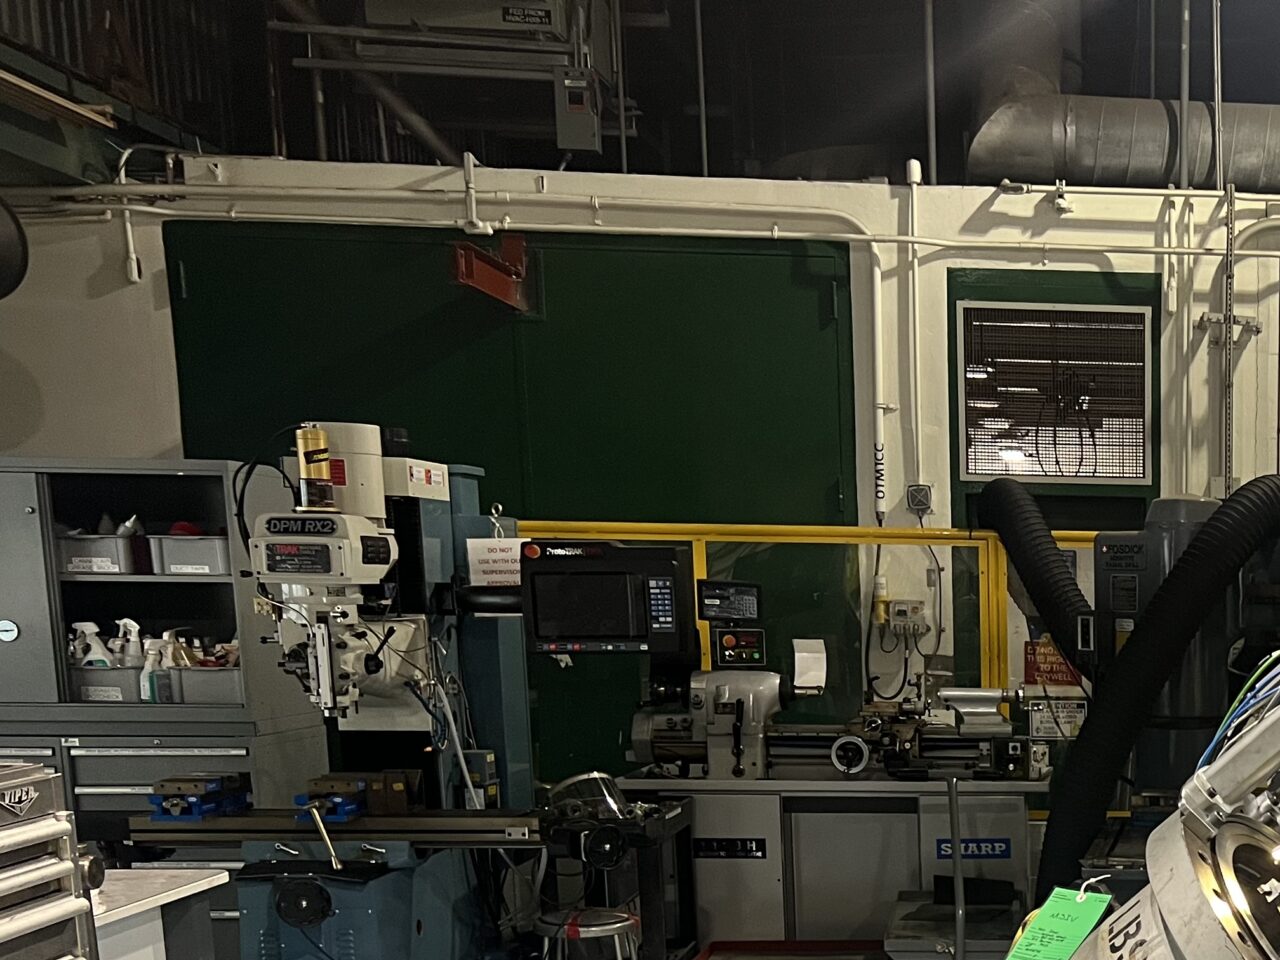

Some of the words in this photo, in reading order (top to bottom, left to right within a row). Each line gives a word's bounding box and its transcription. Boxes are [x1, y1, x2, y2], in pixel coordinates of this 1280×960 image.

[270, 520, 302, 533] DPM
[304, 520, 333, 533] RX2
[546, 547, 582, 555] ProtoTRAK
[1107, 543, 1144, 554] FOSDICK
[1, 786, 35, 804] VIPER
